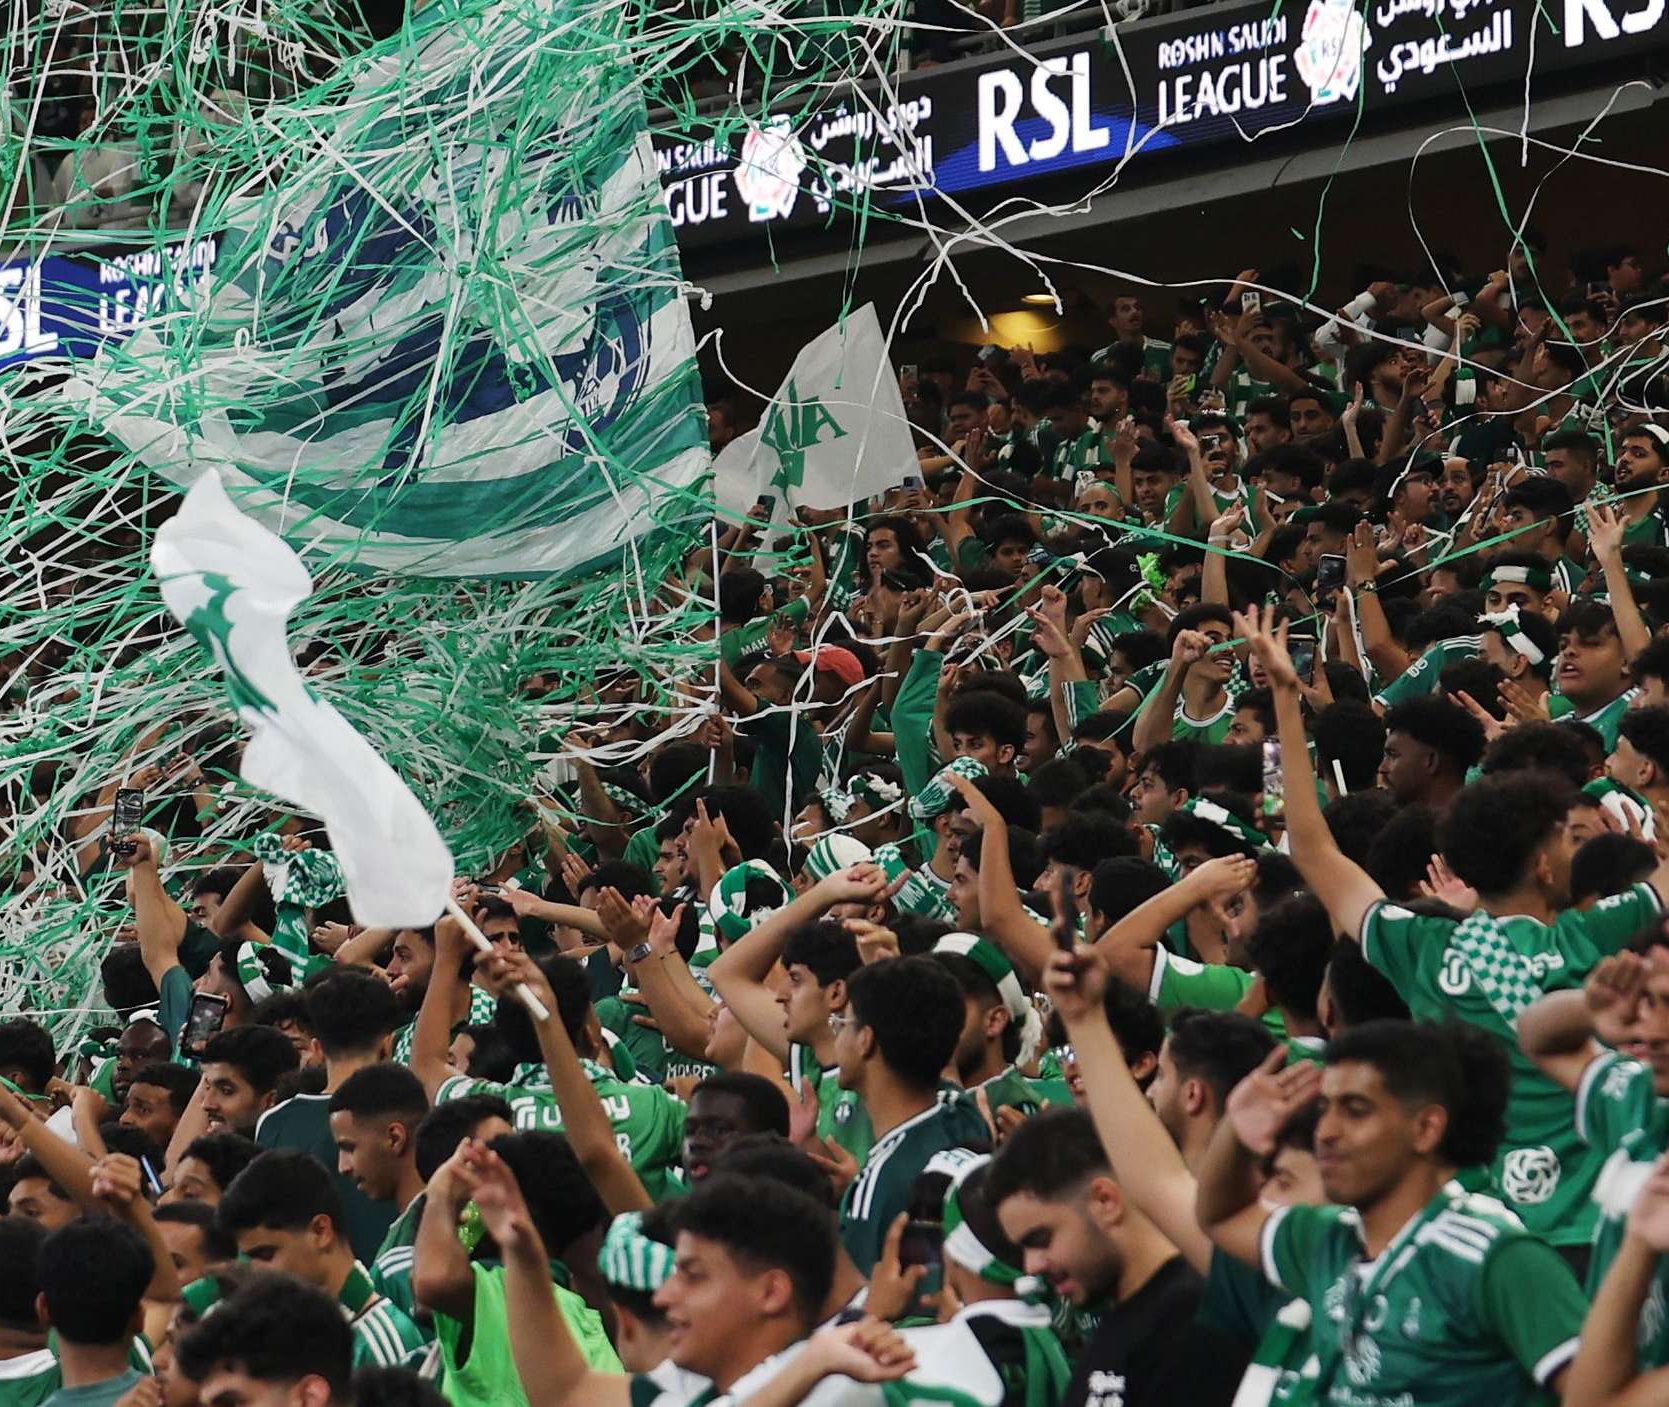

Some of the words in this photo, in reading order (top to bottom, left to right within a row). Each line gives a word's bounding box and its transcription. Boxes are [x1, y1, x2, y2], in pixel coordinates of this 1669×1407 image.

[1157, 31, 1224, 71] ROSHN
[1227, 14, 1288, 55] SAUDI
[1376, 8, 1513, 94] السعودي
[978, 51, 1110, 172] RSL
[1157, 54, 1288, 127] LEAGUE
[663, 172, 728, 227] GUE
